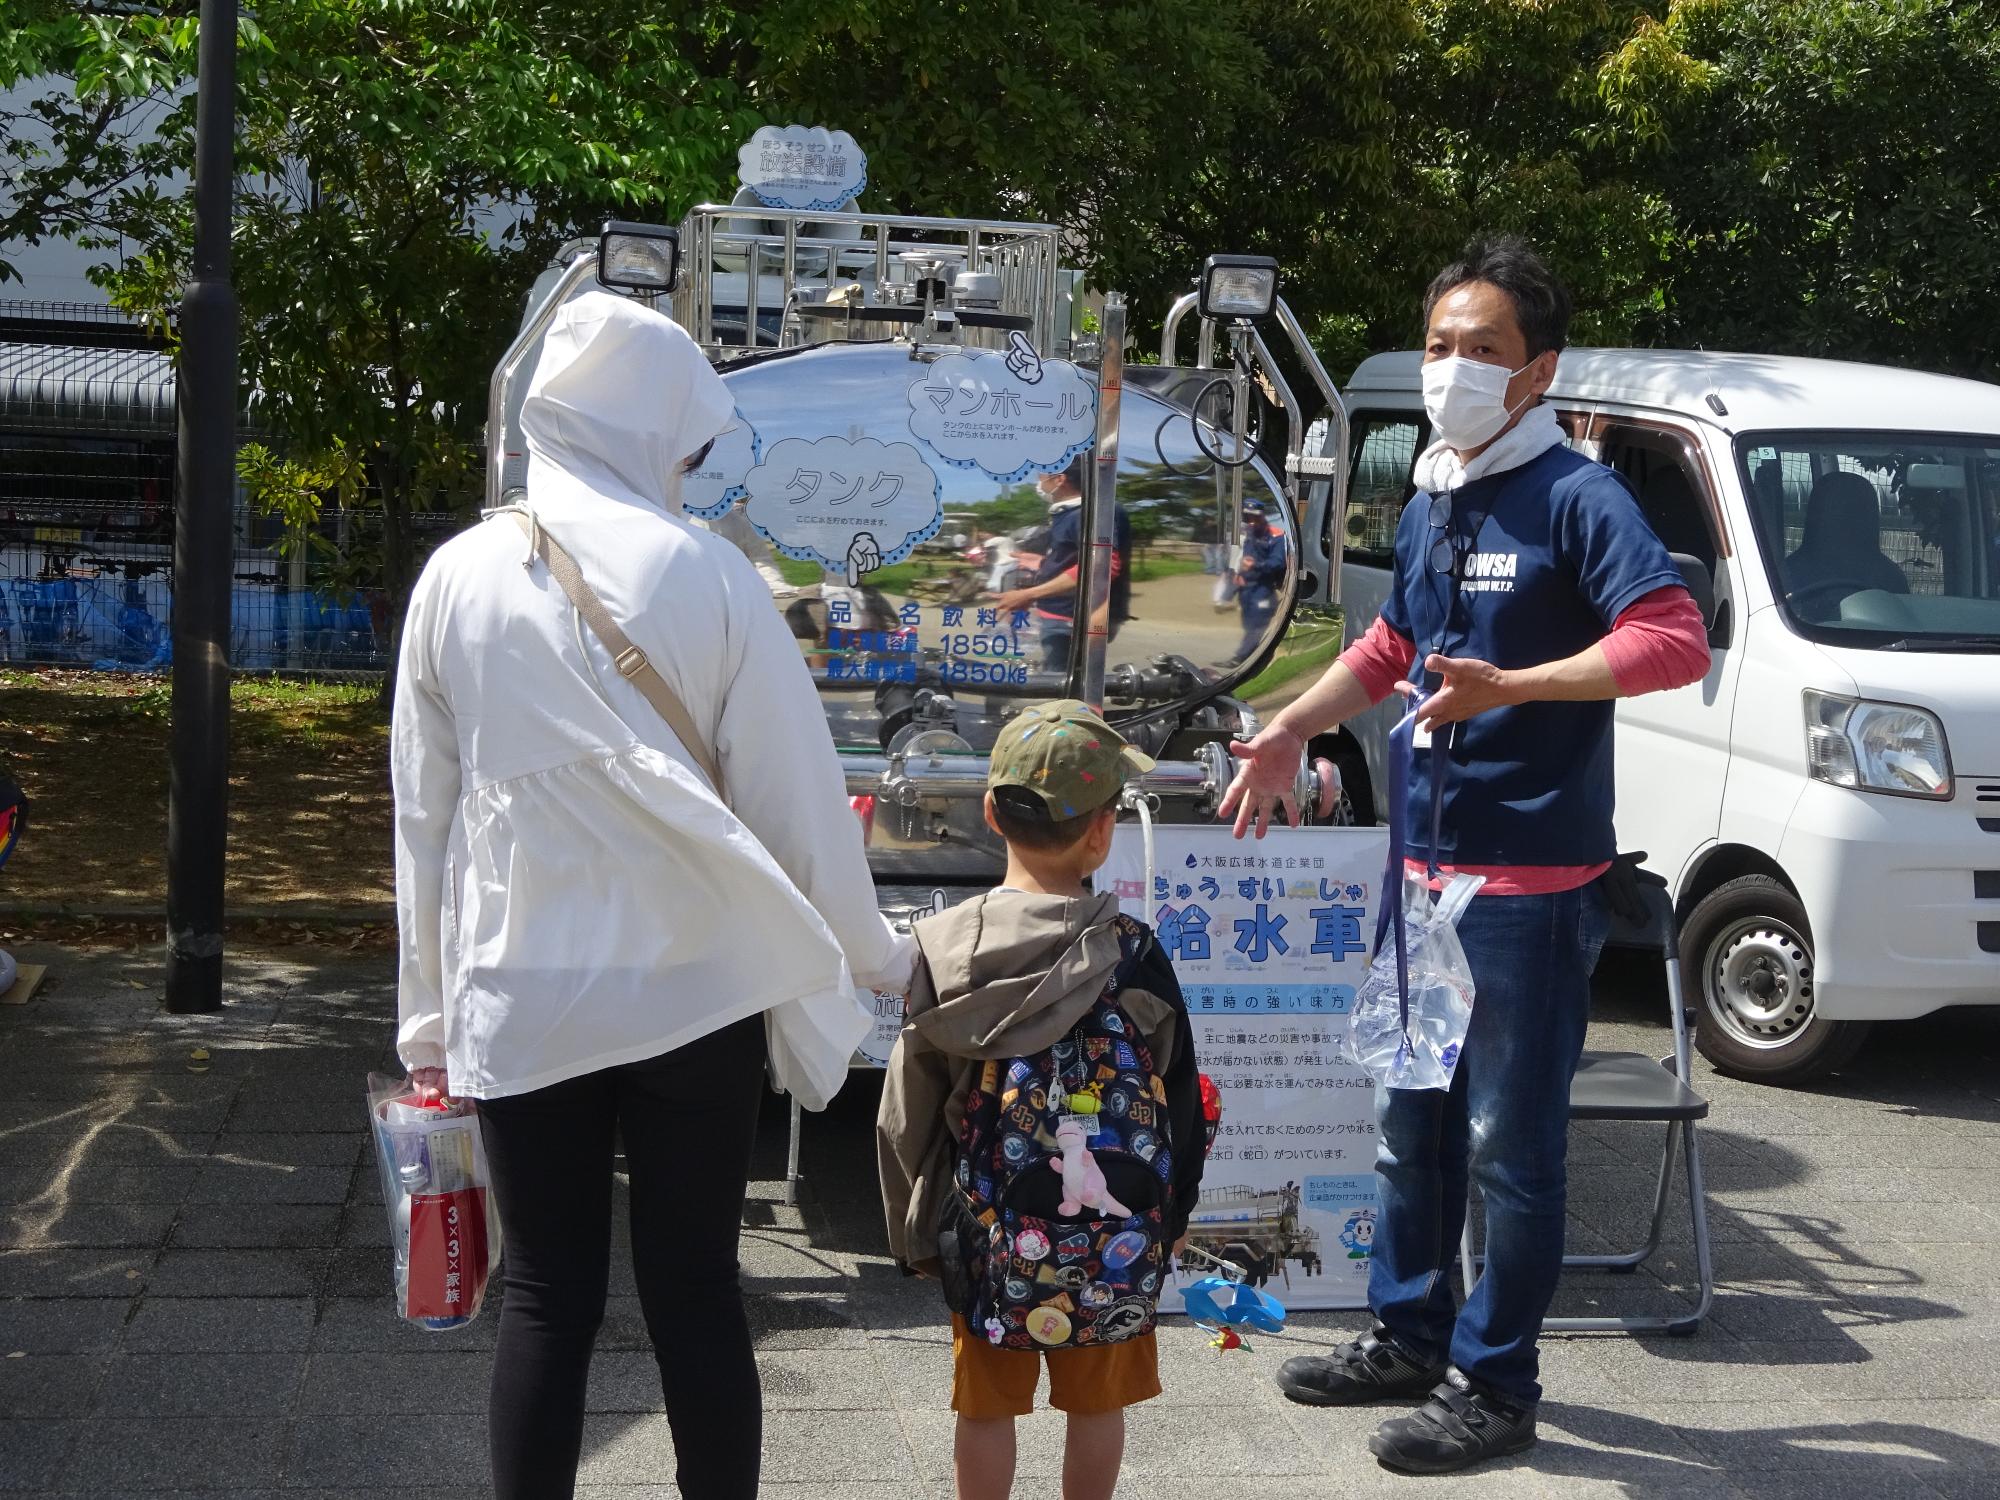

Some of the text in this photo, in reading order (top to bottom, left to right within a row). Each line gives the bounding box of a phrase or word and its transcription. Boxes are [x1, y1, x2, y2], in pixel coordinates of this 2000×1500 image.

[760, 150, 847, 177] 放送設備
[923, 386, 1087, 420] マンホール
[943, 421, 1068, 434] タンクの上にはマンホールがあります。
[943, 431, 1018, 441] ここから水を入れます。
[785, 467, 904, 509] タンク
[796, 515, 889, 527] ここに水を貯めておきます。
[1464, 553, 1517, 577] OWSA
[942, 607, 1030, 628] 飲料水
[940, 634, 1025, 656] 1850L
[938, 662, 1028, 685] 1850kg
[1201, 856, 1325, 869] 大阪広域水道企業団
[1154, 876, 1363, 901] きゅう すい しゃ
[1155, 903, 1366, 962] 給水車
